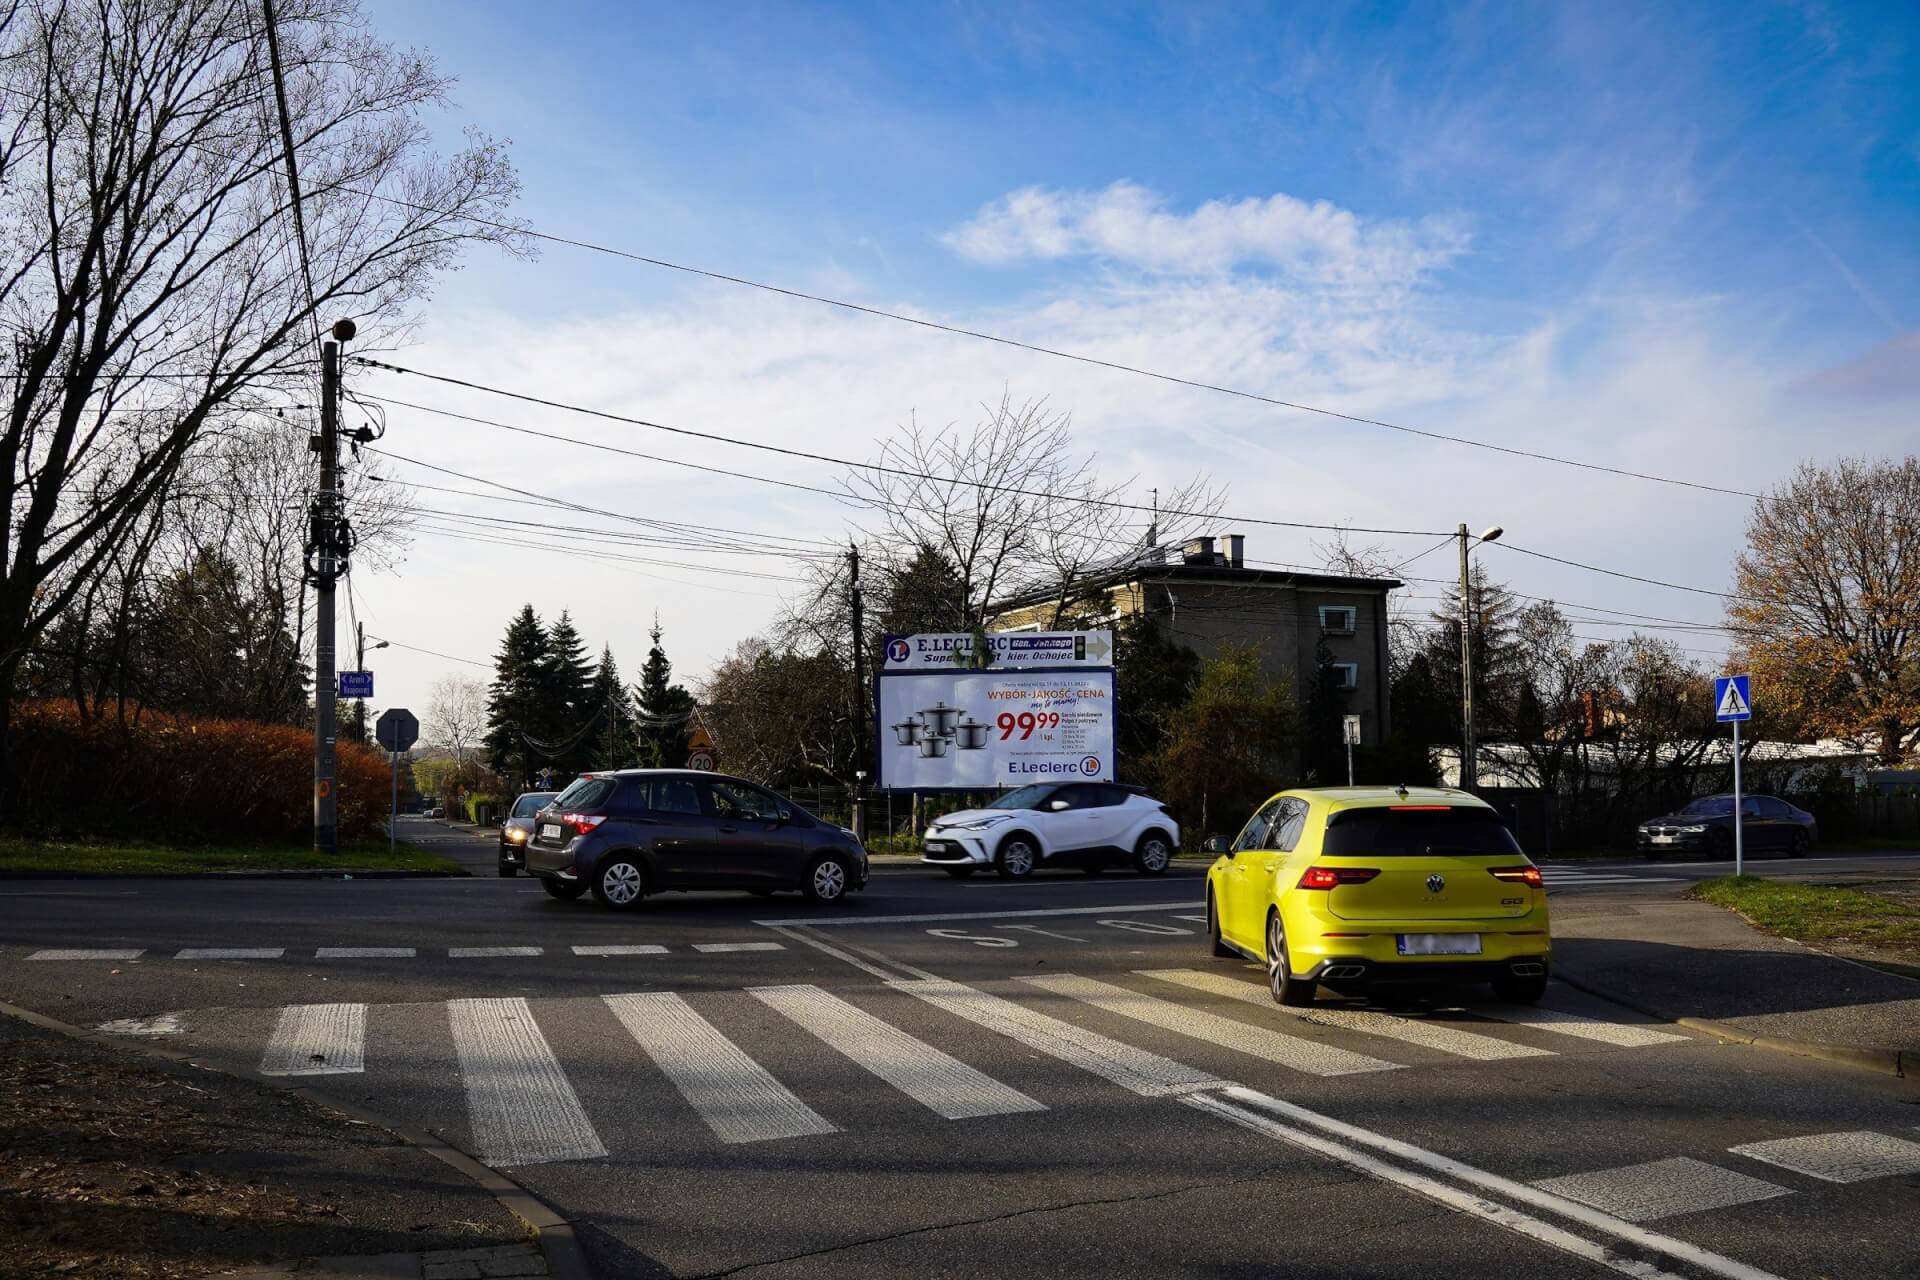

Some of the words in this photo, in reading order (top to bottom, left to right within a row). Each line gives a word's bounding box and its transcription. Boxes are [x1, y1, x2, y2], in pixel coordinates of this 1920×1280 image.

[917, 637, 1007, 652] E.LECLRC
[1007, 652, 1029, 661] kier.
[1032, 651, 1073, 661] Ochojec
[987, 688, 1026, 700] WYBÓR
[1031, 687, 1072, 699] JAKOŚĆ
[1076, 689, 1105, 699] CENA
[695, 758, 711, 770] 20
[1008, 761, 1078, 774] E.Leclerc
